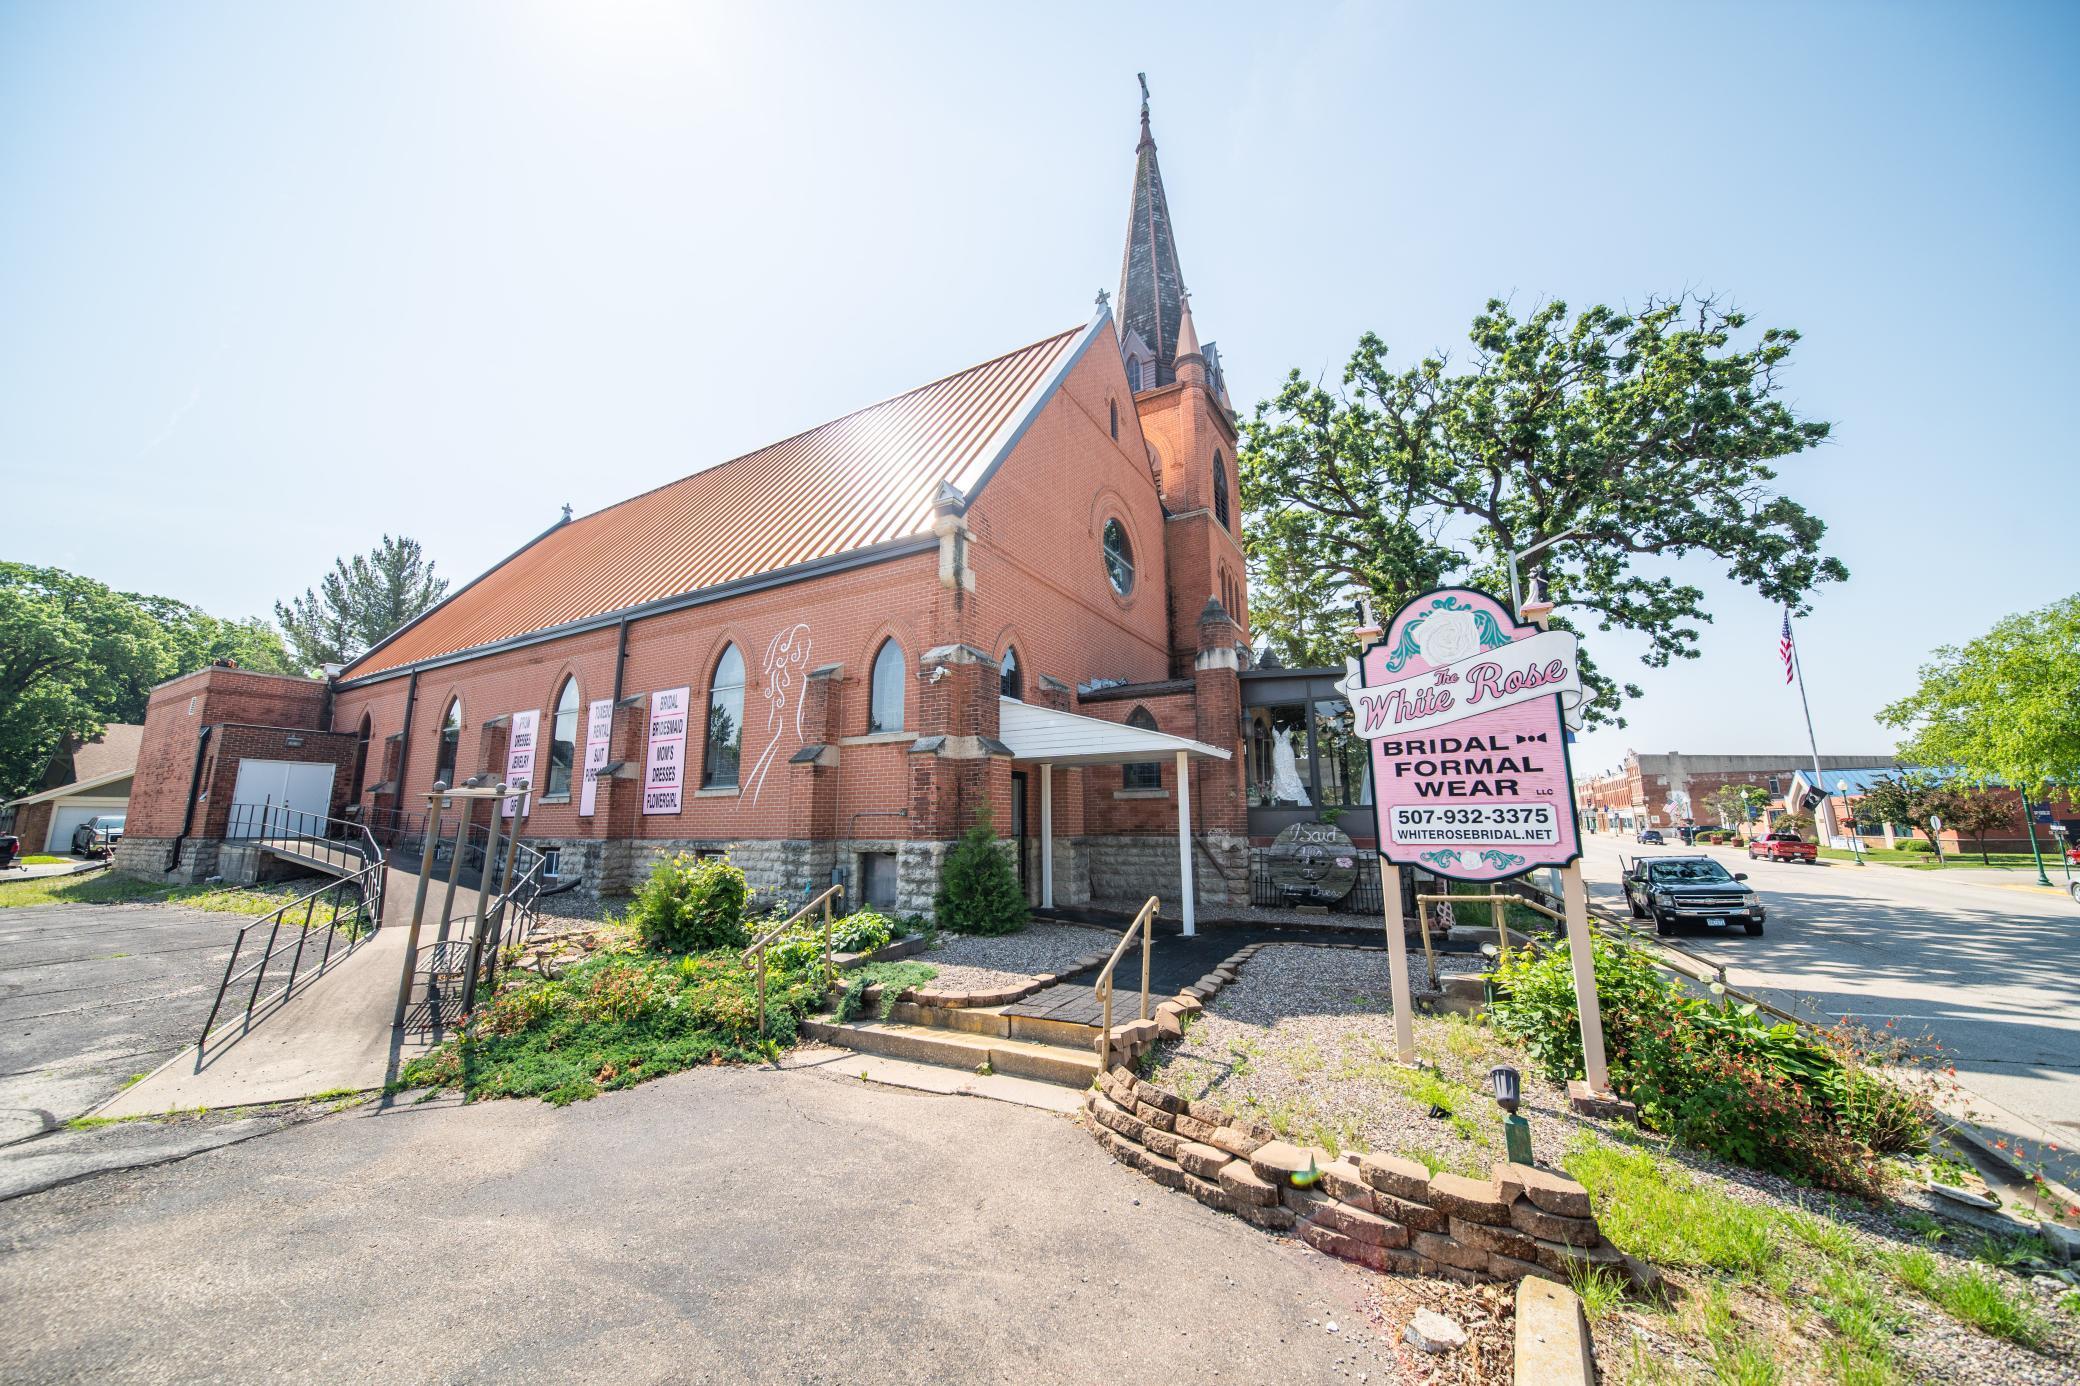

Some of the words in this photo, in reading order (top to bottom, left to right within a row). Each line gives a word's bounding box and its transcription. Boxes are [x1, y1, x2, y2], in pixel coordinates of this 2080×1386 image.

[1434, 667, 1460, 687] The
[659, 693, 679, 712] BRIDAL
[1360, 687, 1455, 733] White
[1465, 658, 1568, 705] Rose
[593, 724, 609, 739] RENTAL
[652, 718, 684, 737] BRIDESMAID
[514, 733, 531, 748] DRESSES
[1383, 735, 1510, 757] BRIDAL
[656, 744, 674, 762] MOM'S
[651, 766, 676, 783] DRESSES
[1395, 756, 1544, 778] FORMAL
[1414, 779, 1520, 798] WEAR
[1536, 787, 1554, 796] LLC
[646, 792, 678, 810] FLOWERGIRL
[1398, 808, 1549, 826] 507-932-3375
[1300, 822, 1337, 842] Said
[1397, 828, 1552, 841] WHITEROSEBRIDAL.NET
